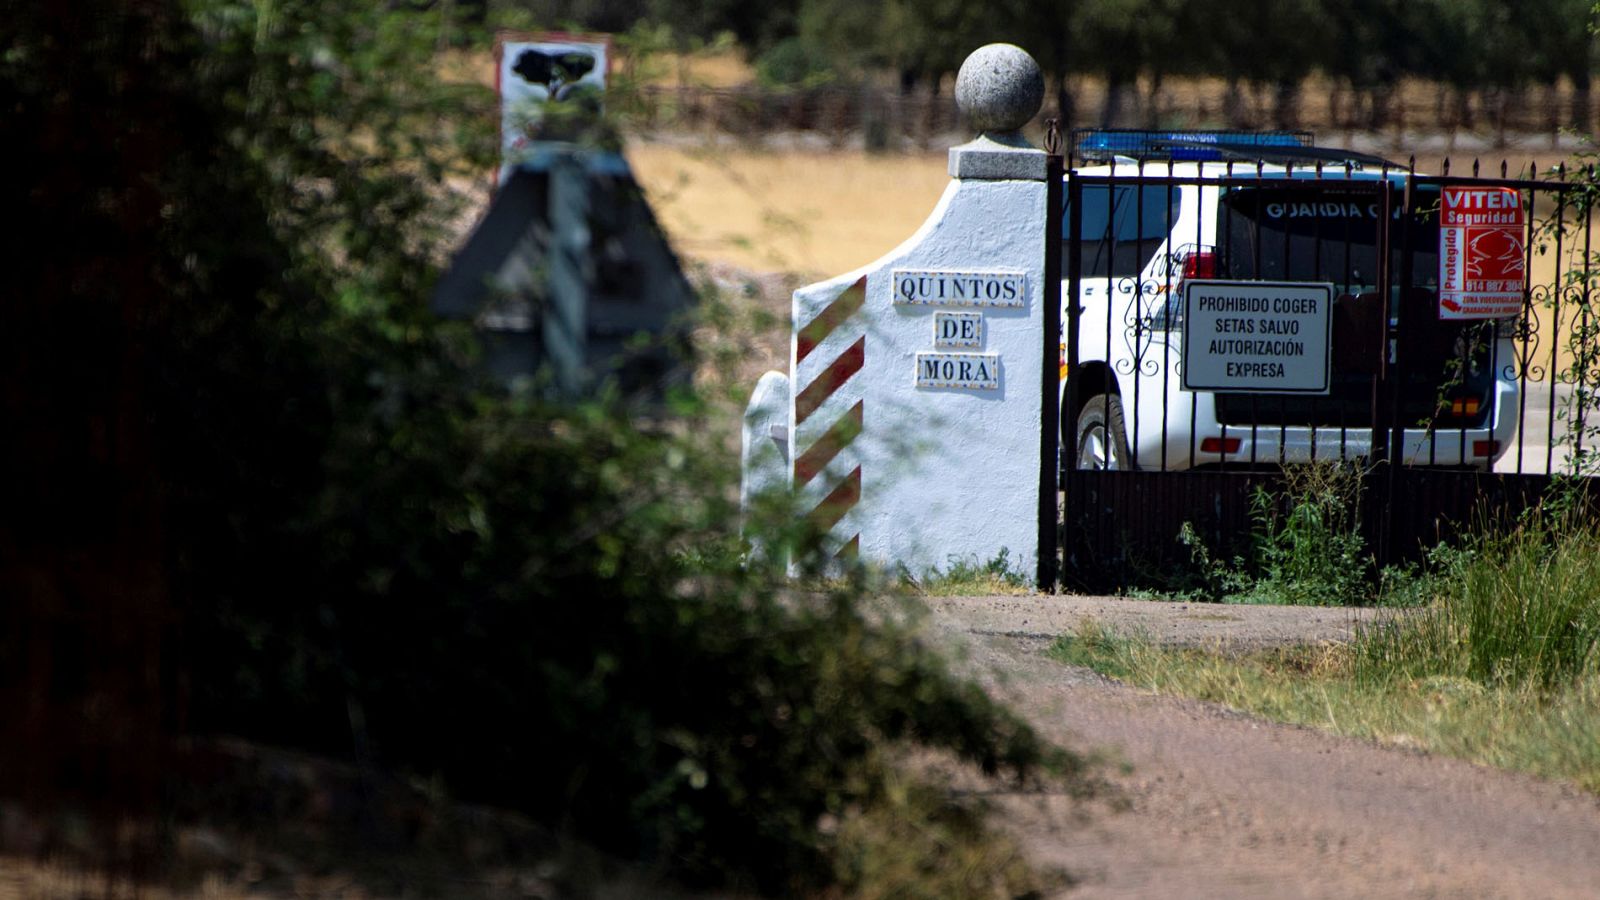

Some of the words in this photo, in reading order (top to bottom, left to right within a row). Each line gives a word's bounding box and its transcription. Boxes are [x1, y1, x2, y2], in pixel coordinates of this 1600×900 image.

[1444, 191, 1519, 208] VITEN
[1448, 210, 1516, 226] Seguridad
[1445, 229, 1459, 289] Protegido
[901, 278, 1017, 301] QUINTOS
[1199, 297, 1269, 313] PROHIBIDO
[1273, 299, 1317, 314] COGER
[942, 320, 974, 339] DE
[1216, 319, 1254, 333] SETAS
[1260, 320, 1299, 335] SALVO
[1209, 338, 1304, 356] AUTORIZACIÓN
[924, 360, 991, 381] MORA
[1227, 362, 1285, 377] EXPRESA
